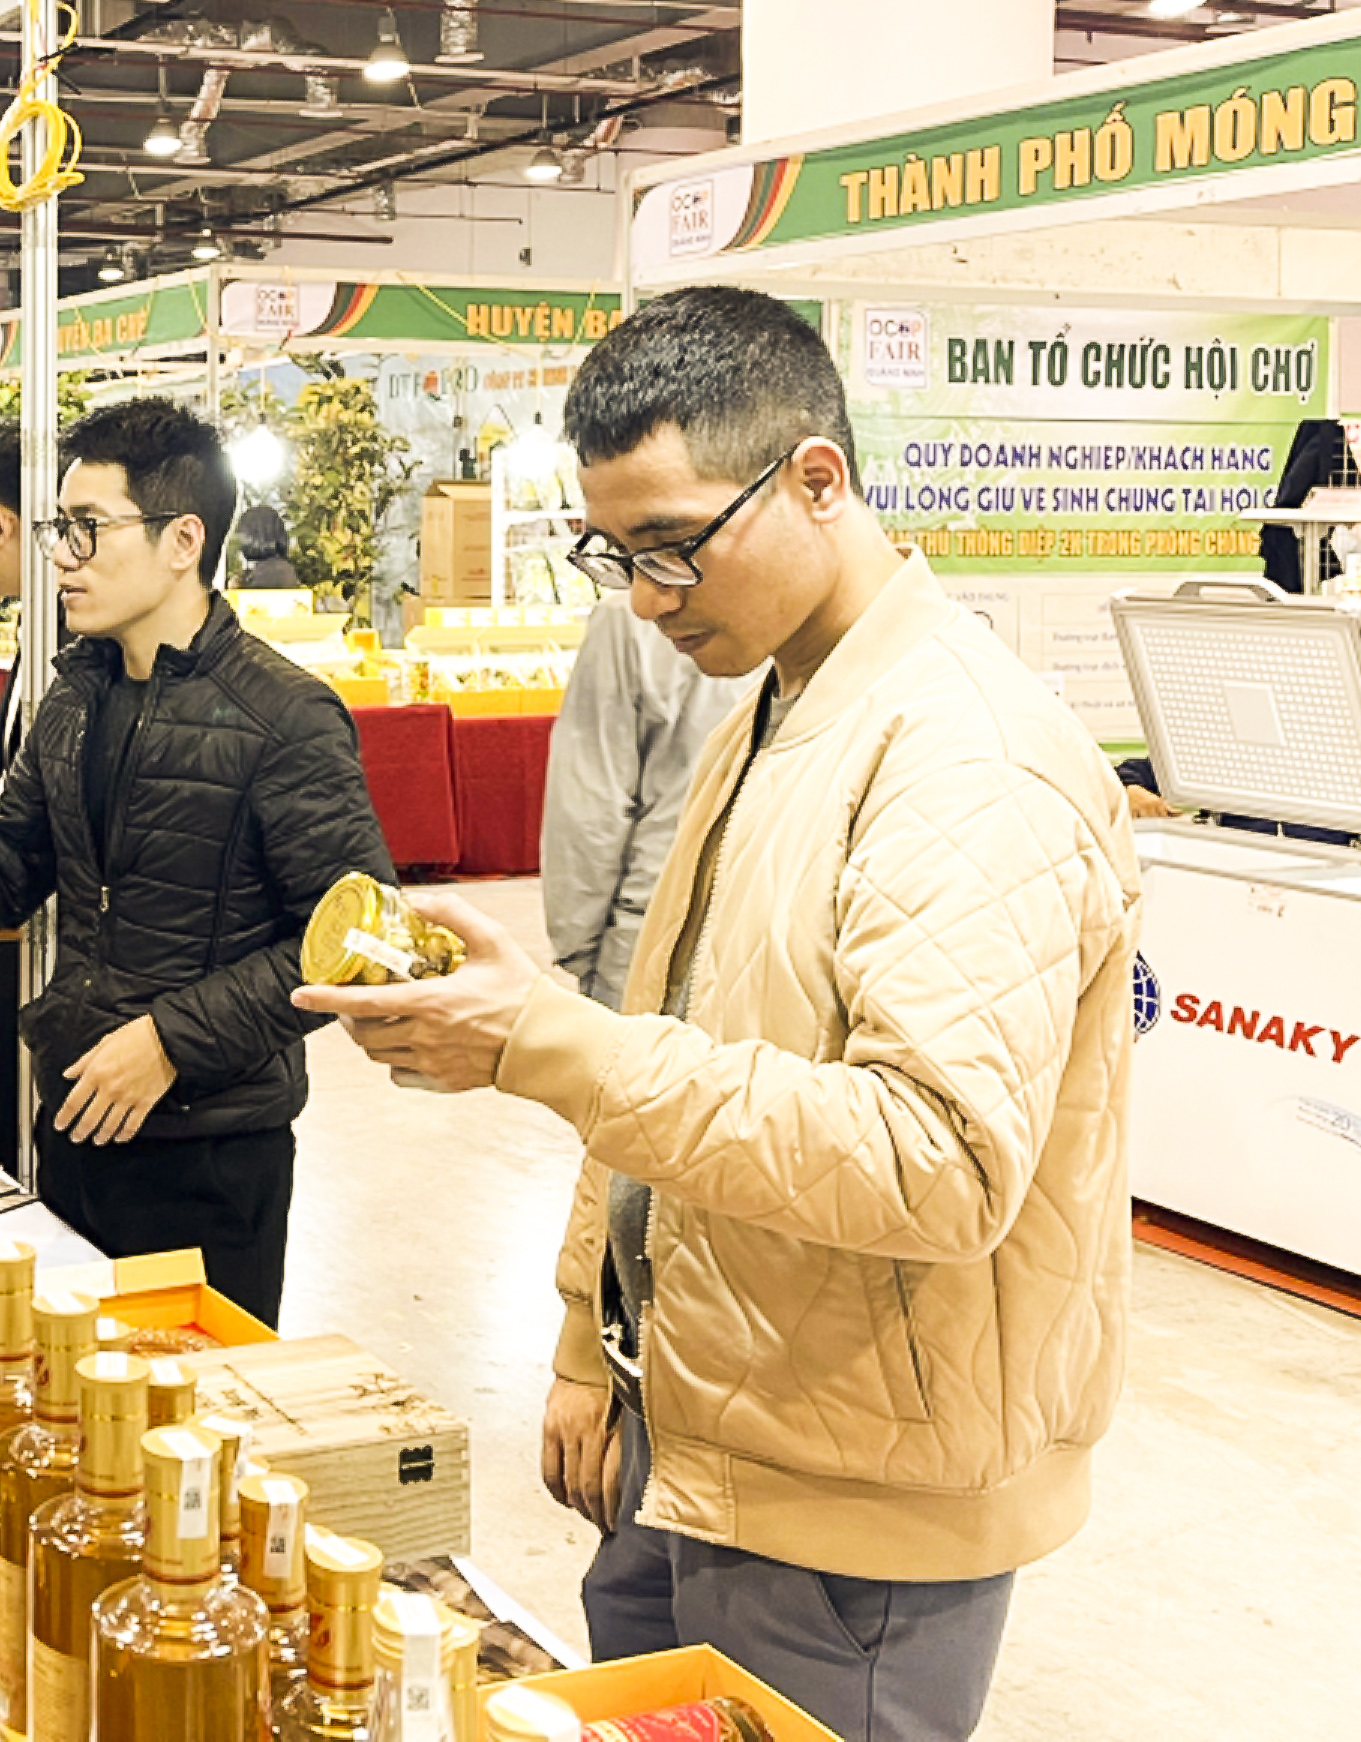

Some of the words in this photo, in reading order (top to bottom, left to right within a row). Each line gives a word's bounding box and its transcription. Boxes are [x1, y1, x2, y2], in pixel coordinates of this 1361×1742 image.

[840, 146, 1001, 223] THÀNH
[1018, 101, 1134, 196] PHỐ
[1154, 77, 1358, 173] MÓNG
[466, 302, 574, 341] HUYỆN
[869, 341, 922, 361] FAIR
[947, 337, 1015, 386] BAN
[1028, 323, 1072, 387] TỔ
[1081, 335, 1171, 389] CHỨC
[1184, 337, 1238, 400] HỘI
[1251, 340, 1316, 402] CHỢ
[960, 443, 1041, 468] DOANH
[1170, 993, 1361, 1065] SANAKY
